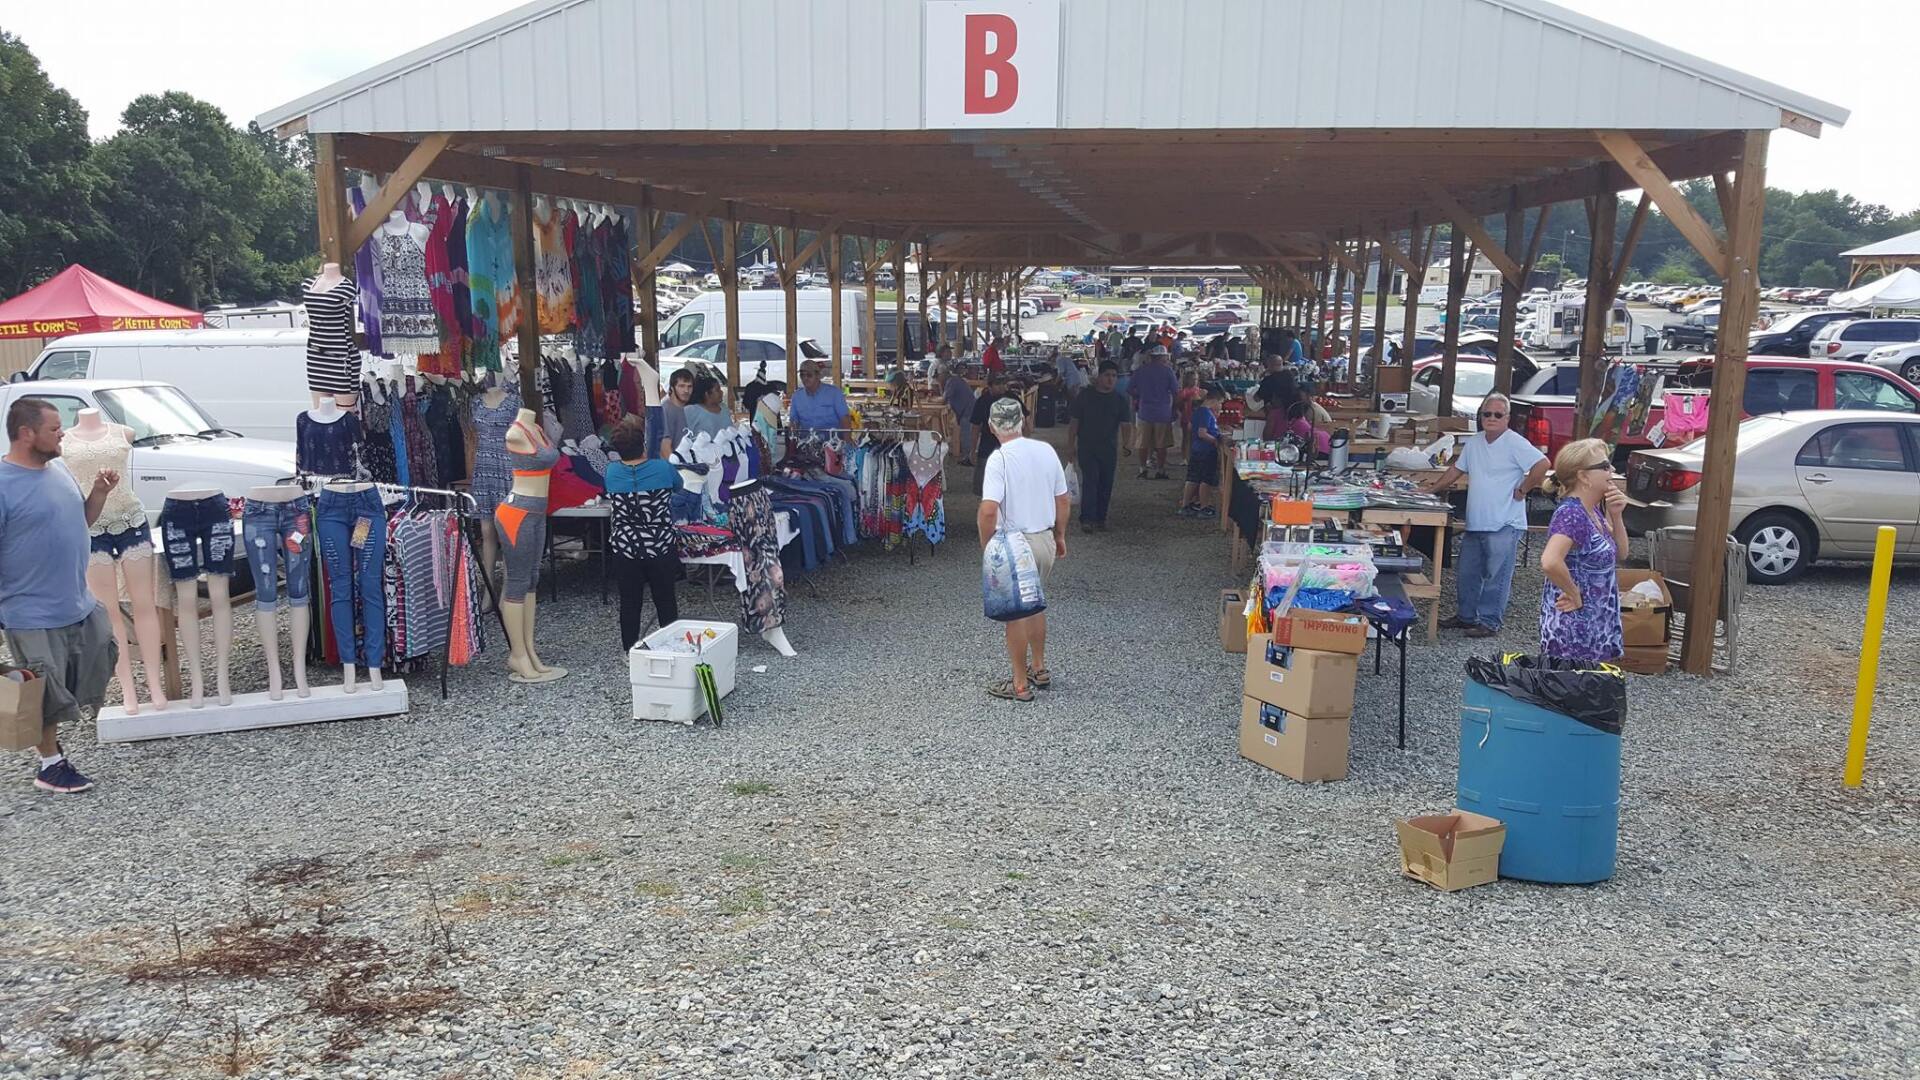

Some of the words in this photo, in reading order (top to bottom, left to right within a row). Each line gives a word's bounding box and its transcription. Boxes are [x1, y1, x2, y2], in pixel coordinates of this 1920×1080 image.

[964, 14, 1019, 115] B
[0, 323, 28, 335] ETTLE
[33, 321, 65, 333] CORN
[124, 317, 156, 329] KETTLE
[159, 317, 182, 329] CORN
[1303, 620, 1359, 634] IMPROVING
